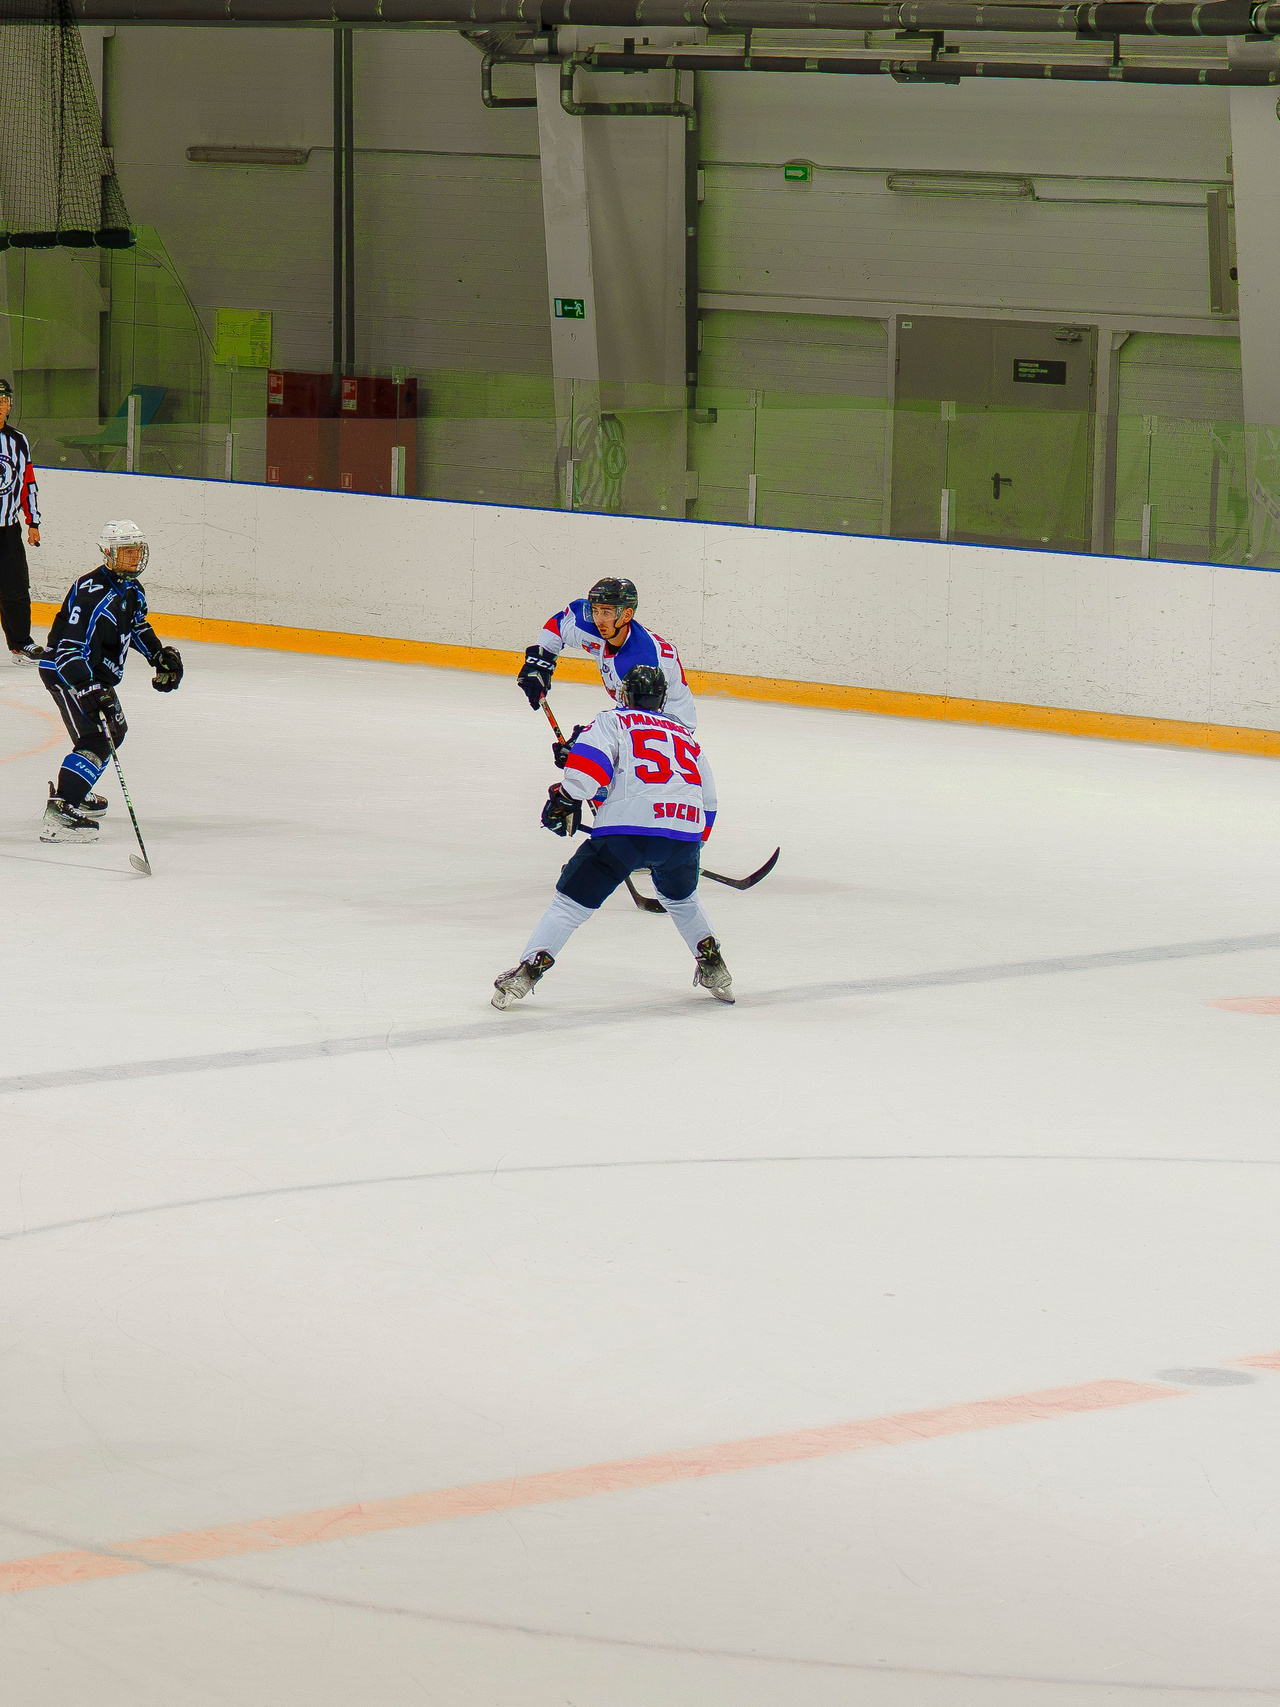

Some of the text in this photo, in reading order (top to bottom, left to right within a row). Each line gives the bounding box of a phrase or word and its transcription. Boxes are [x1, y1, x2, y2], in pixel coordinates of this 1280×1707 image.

[68, 605, 82, 625] 6
[631, 729, 702, 786] 55
[653, 802, 700, 823] SOCHI
